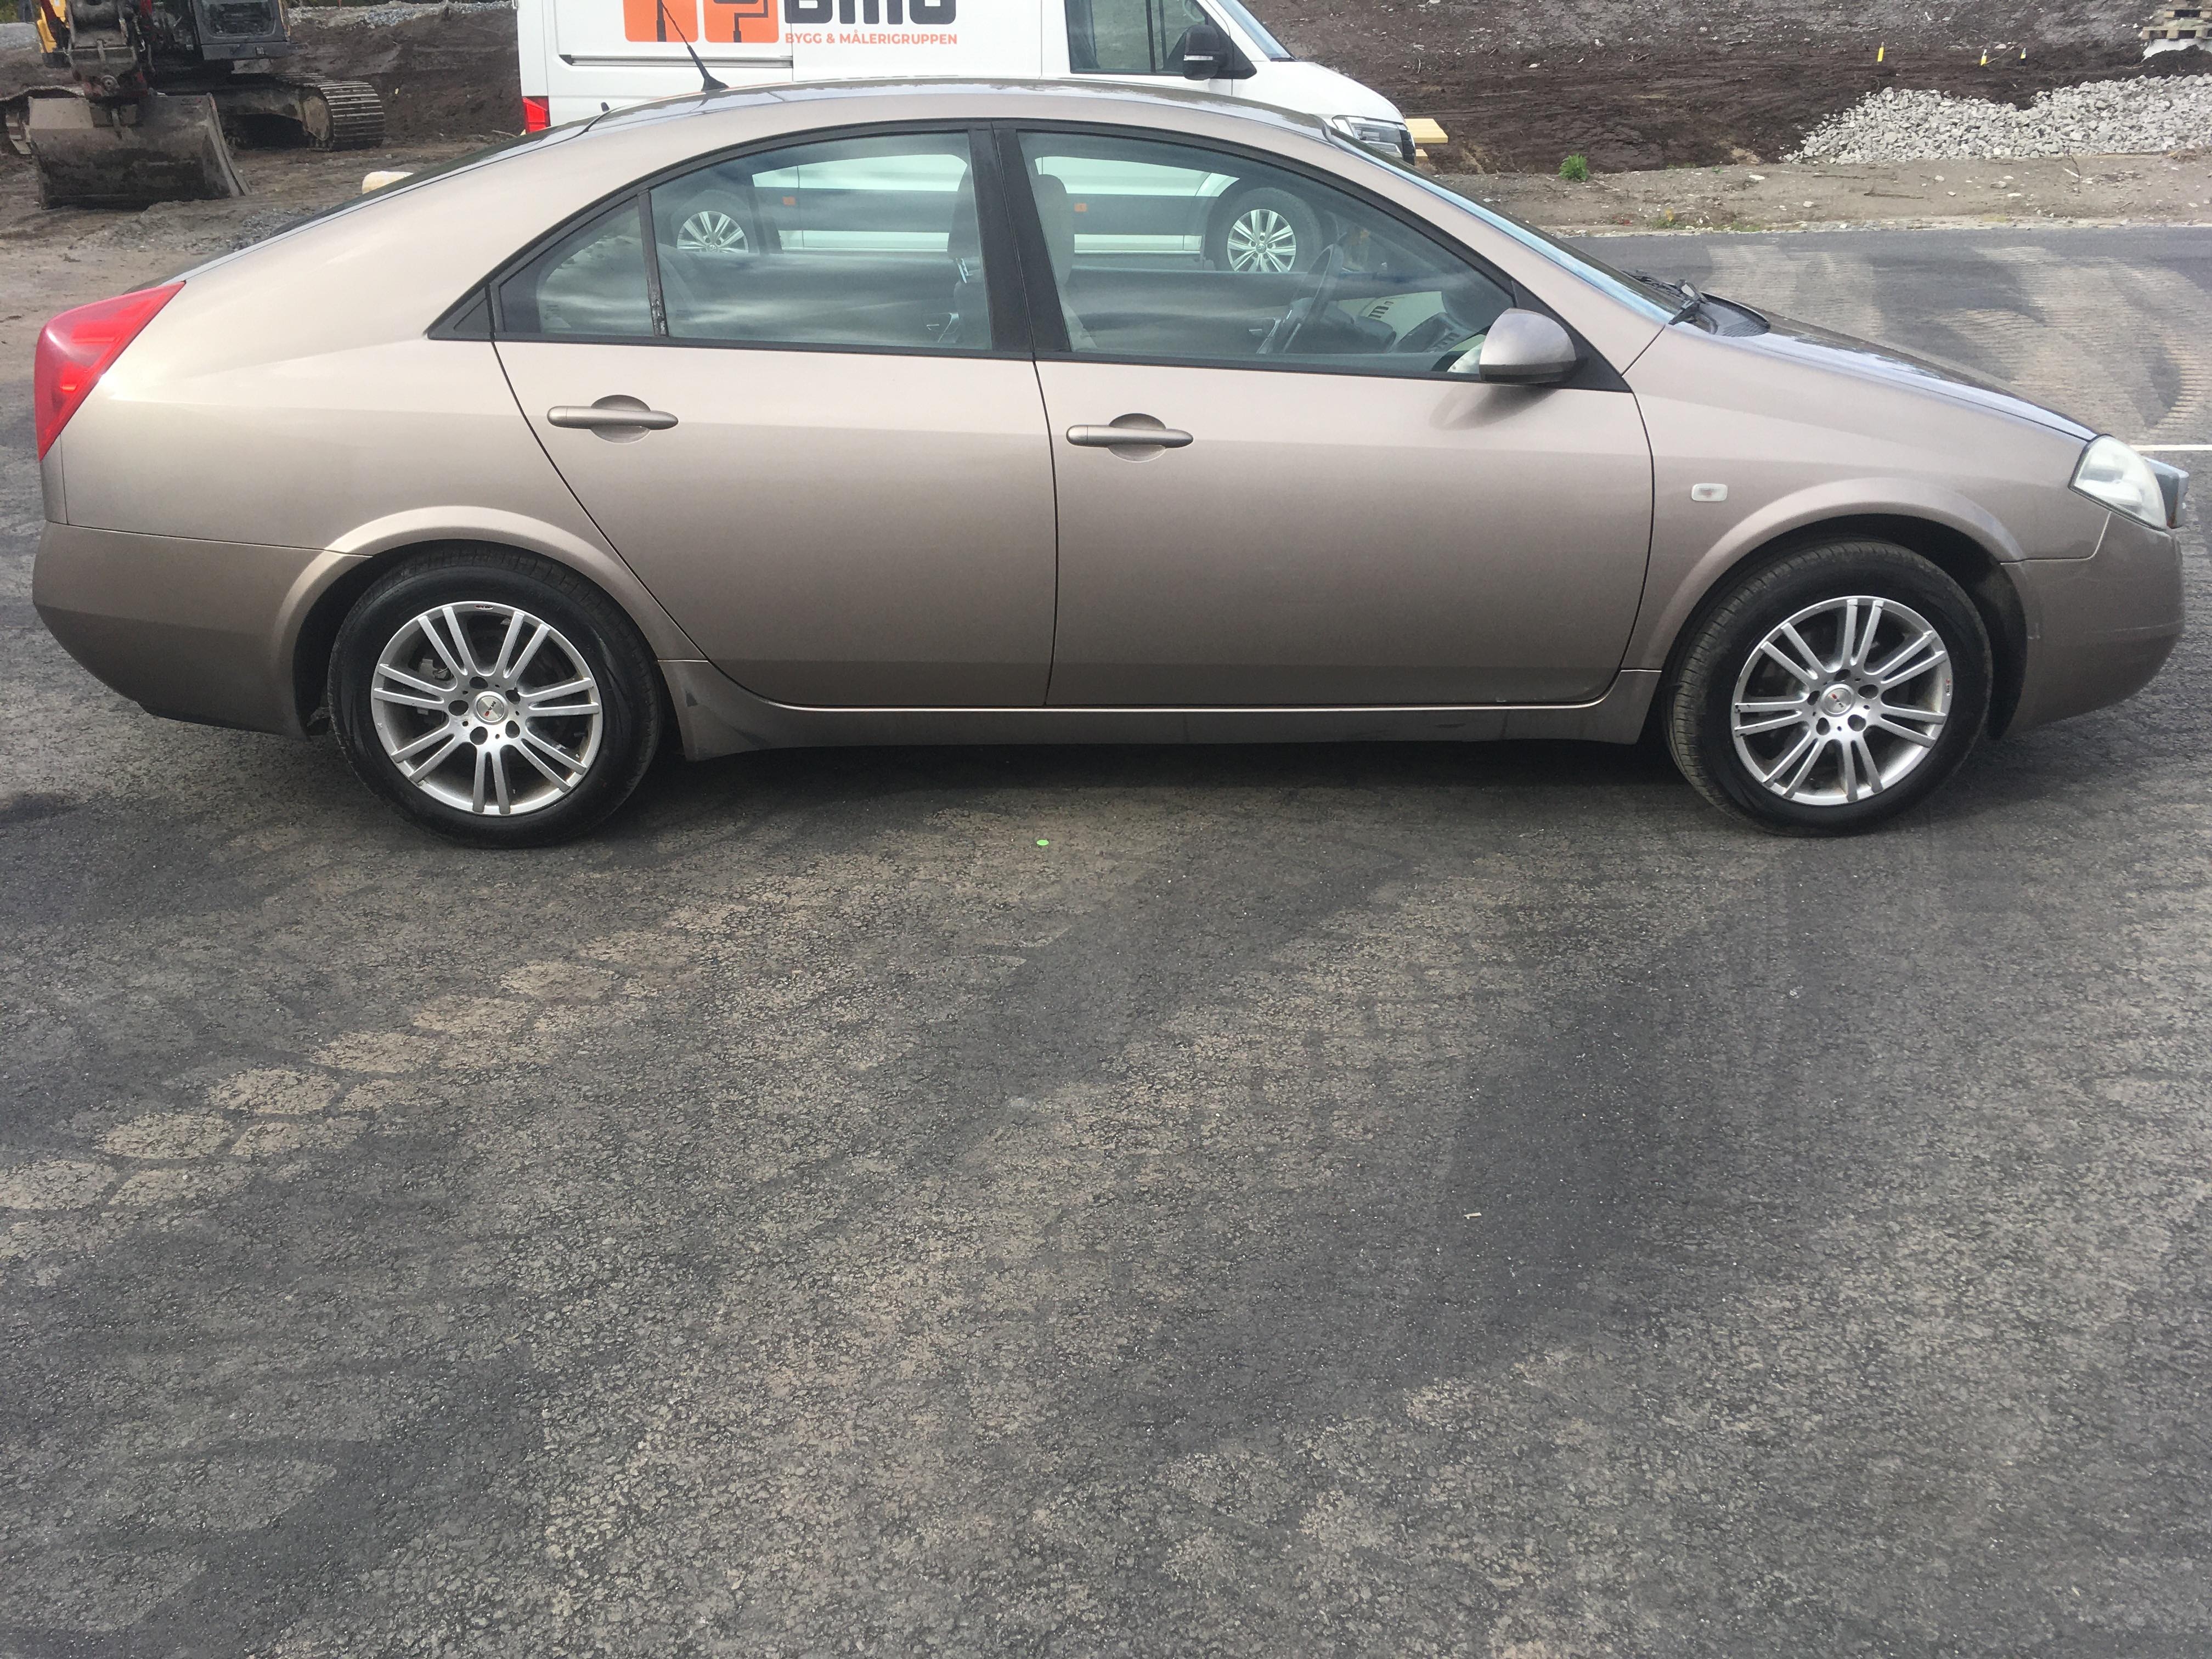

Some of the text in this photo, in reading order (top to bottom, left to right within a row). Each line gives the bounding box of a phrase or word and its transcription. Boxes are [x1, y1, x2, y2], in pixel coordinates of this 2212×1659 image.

[785, 30, 957, 44] BYGG & MÅLERIGRUPPEN
